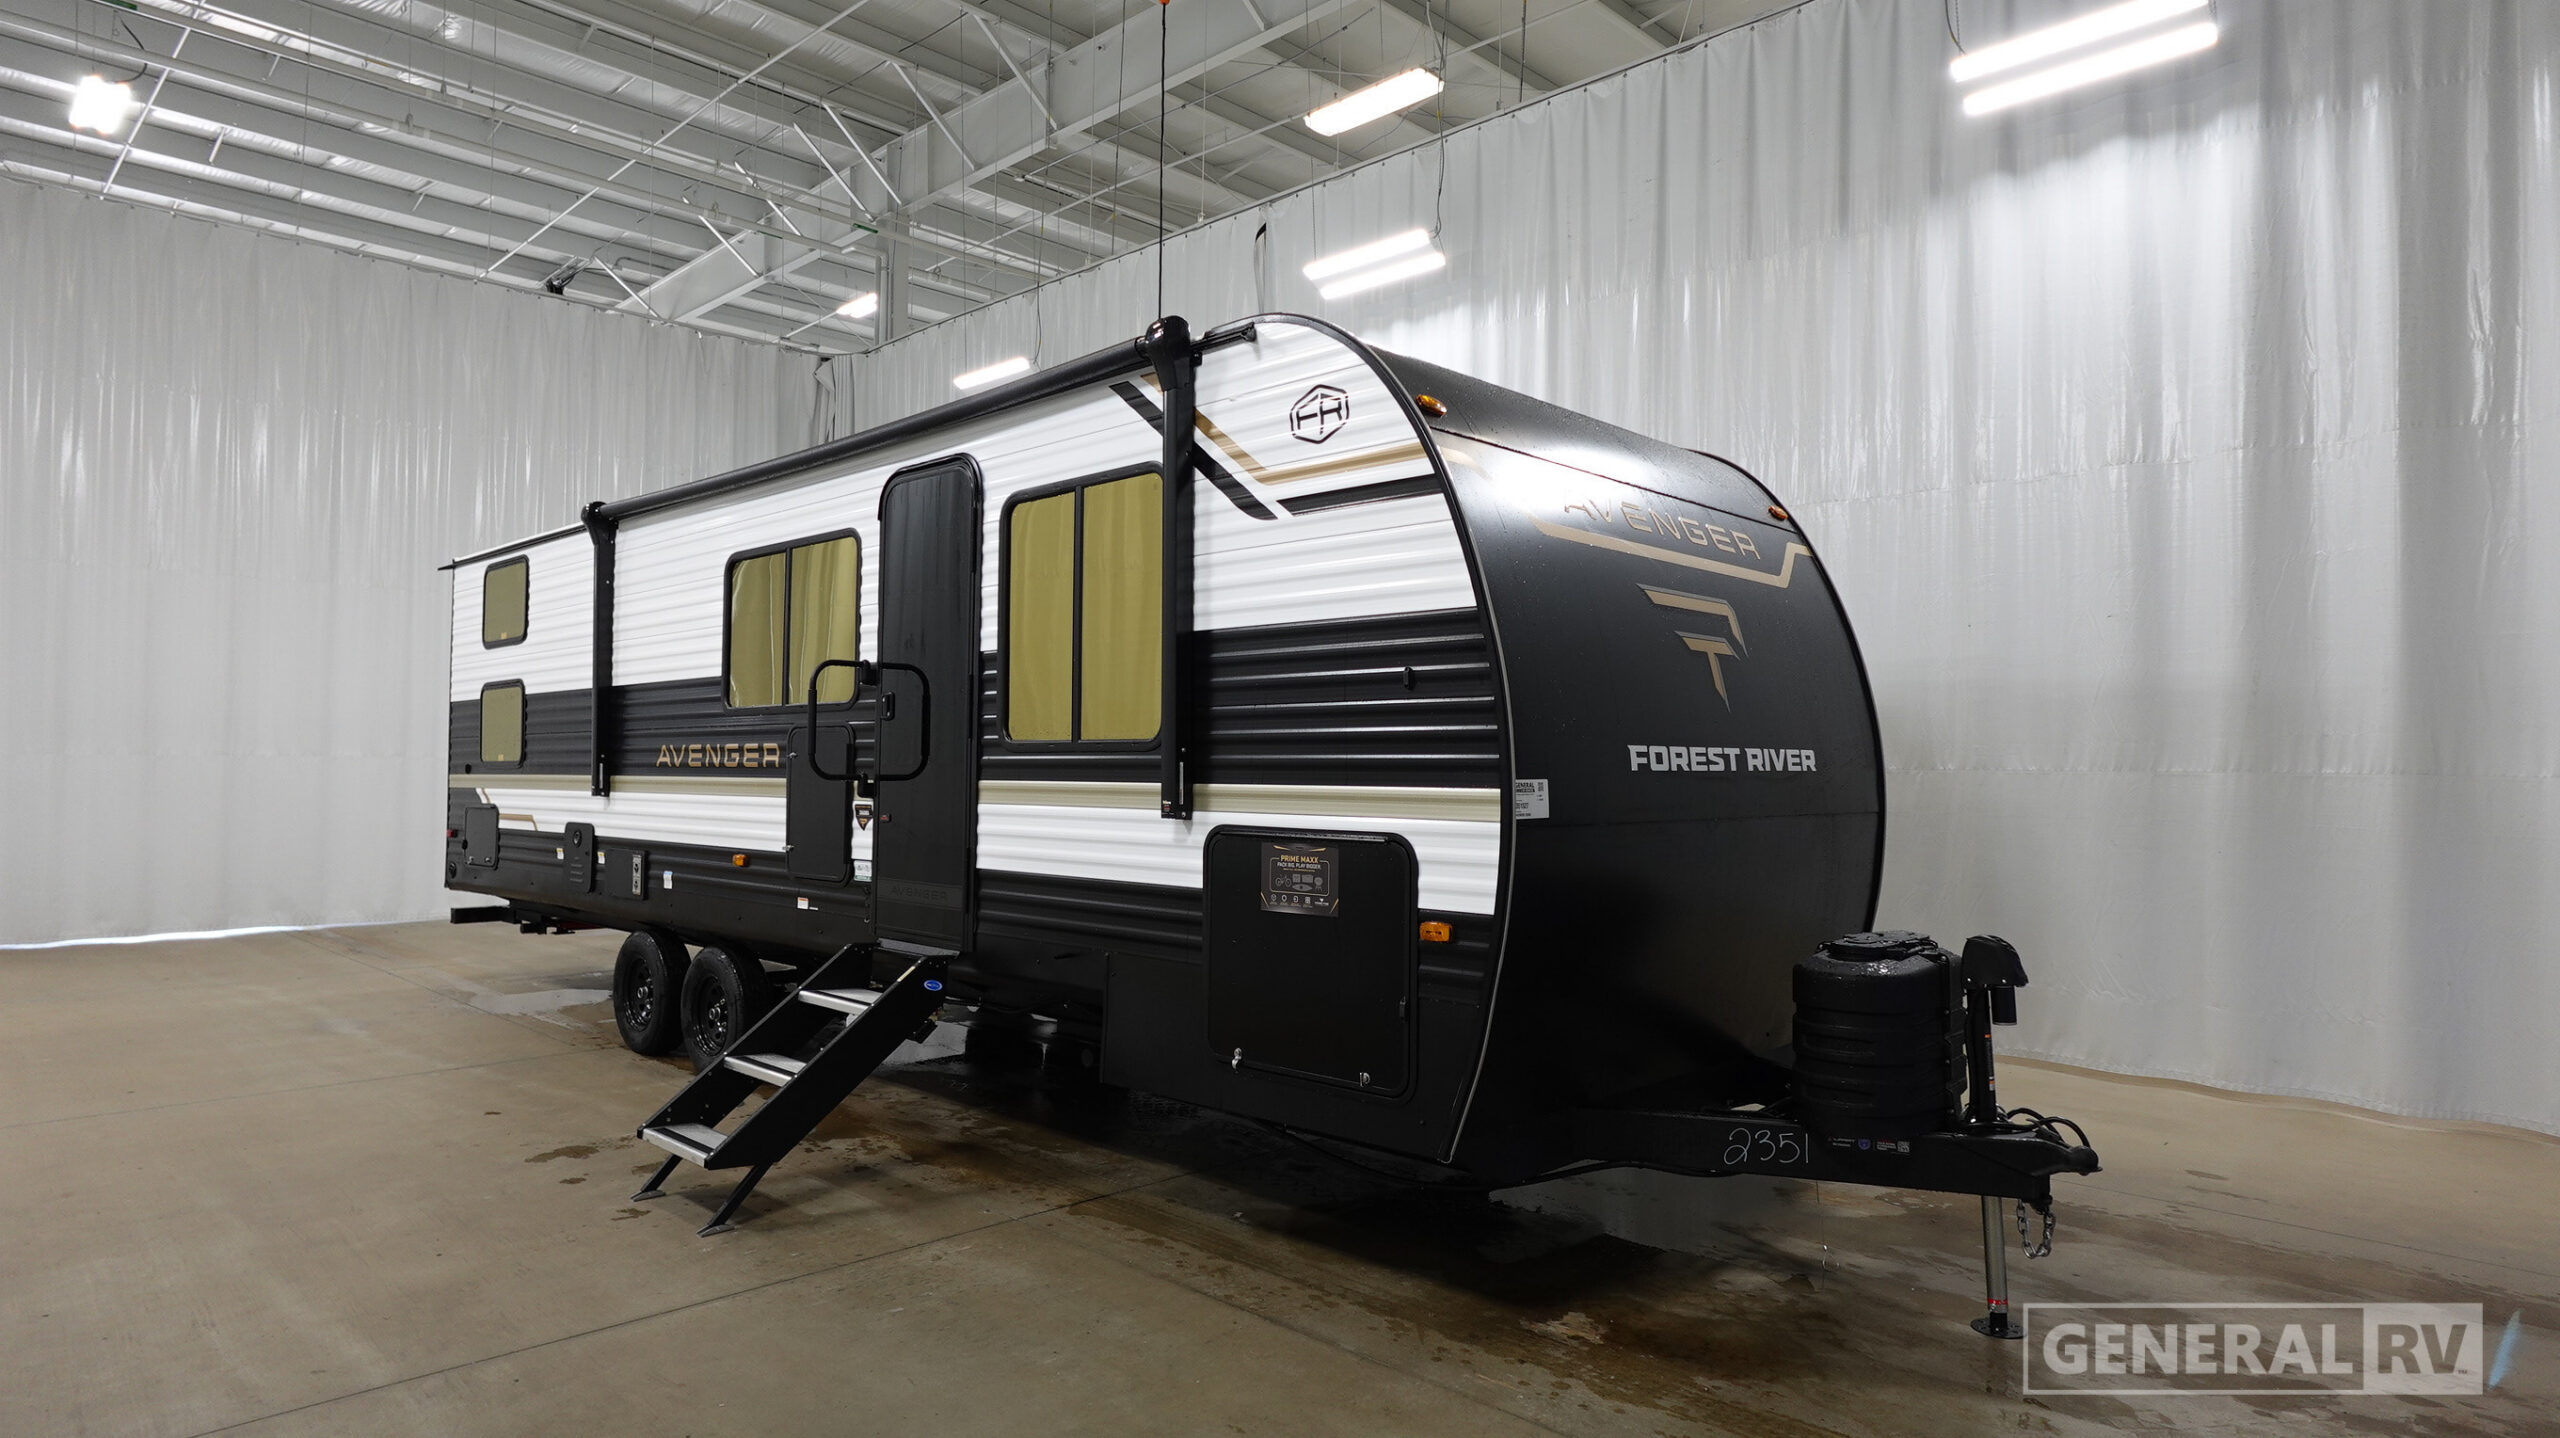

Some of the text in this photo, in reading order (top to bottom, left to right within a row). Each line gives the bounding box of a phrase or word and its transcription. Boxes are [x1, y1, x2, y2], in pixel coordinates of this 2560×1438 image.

[1564, 499, 1760, 560] AVENGER
[656, 743, 780, 768] AVENGER
[1627, 745, 1817, 772] FOREST RIVER
[1280, 855, 1319, 864] PRIME MAXX
[889, 884, 948, 901] AVENGER
[1723, 1127, 1809, 1165] 2351
